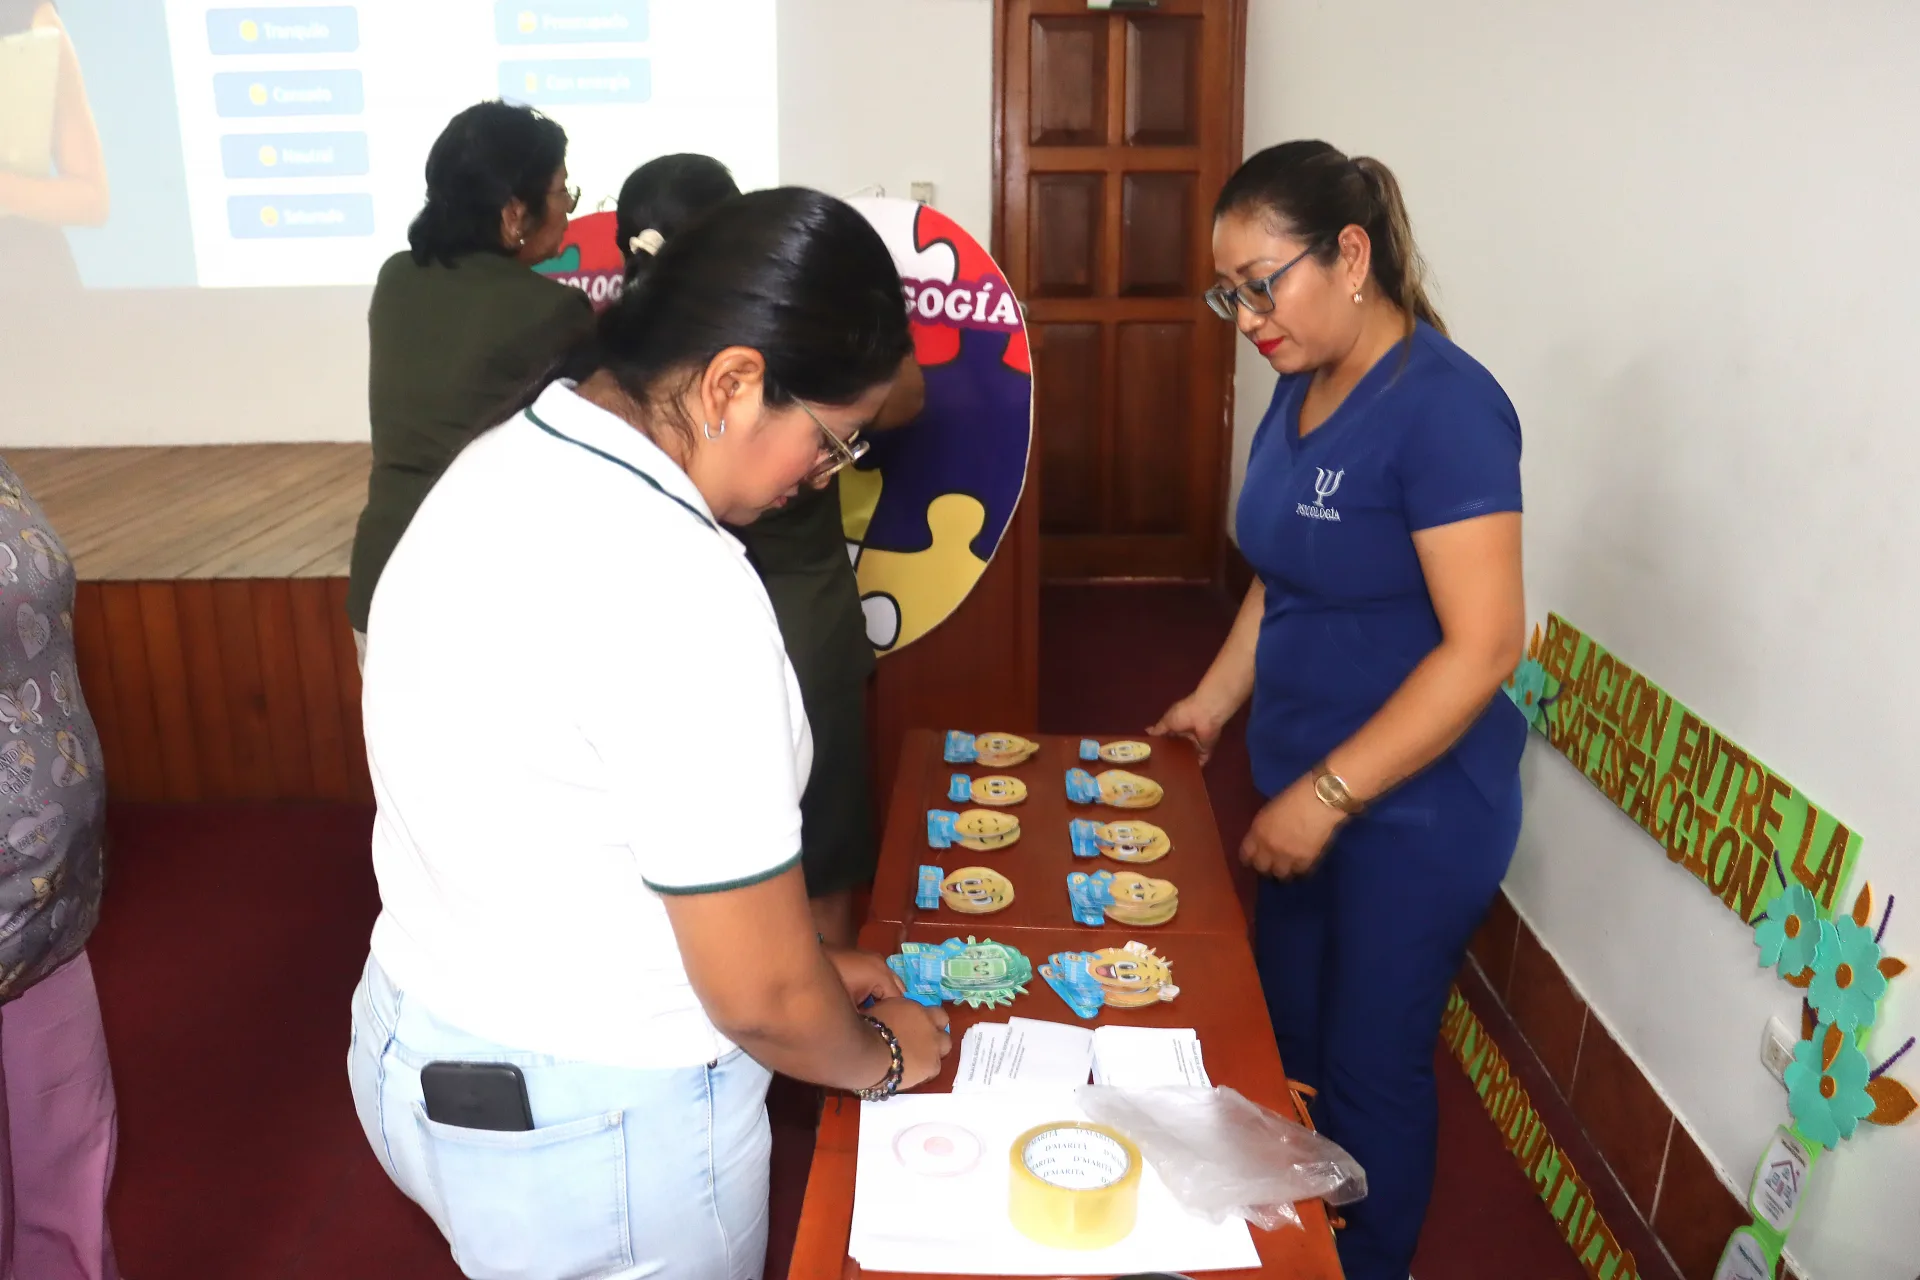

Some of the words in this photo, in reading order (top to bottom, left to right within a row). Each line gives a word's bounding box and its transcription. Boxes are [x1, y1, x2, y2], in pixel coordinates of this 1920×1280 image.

[1538, 612, 1672, 757] RELACION
[1669, 711, 1792, 862] ENTRE
[1790, 802, 1850, 911] LA
[1550, 688, 1770, 924] SATISFACCION
